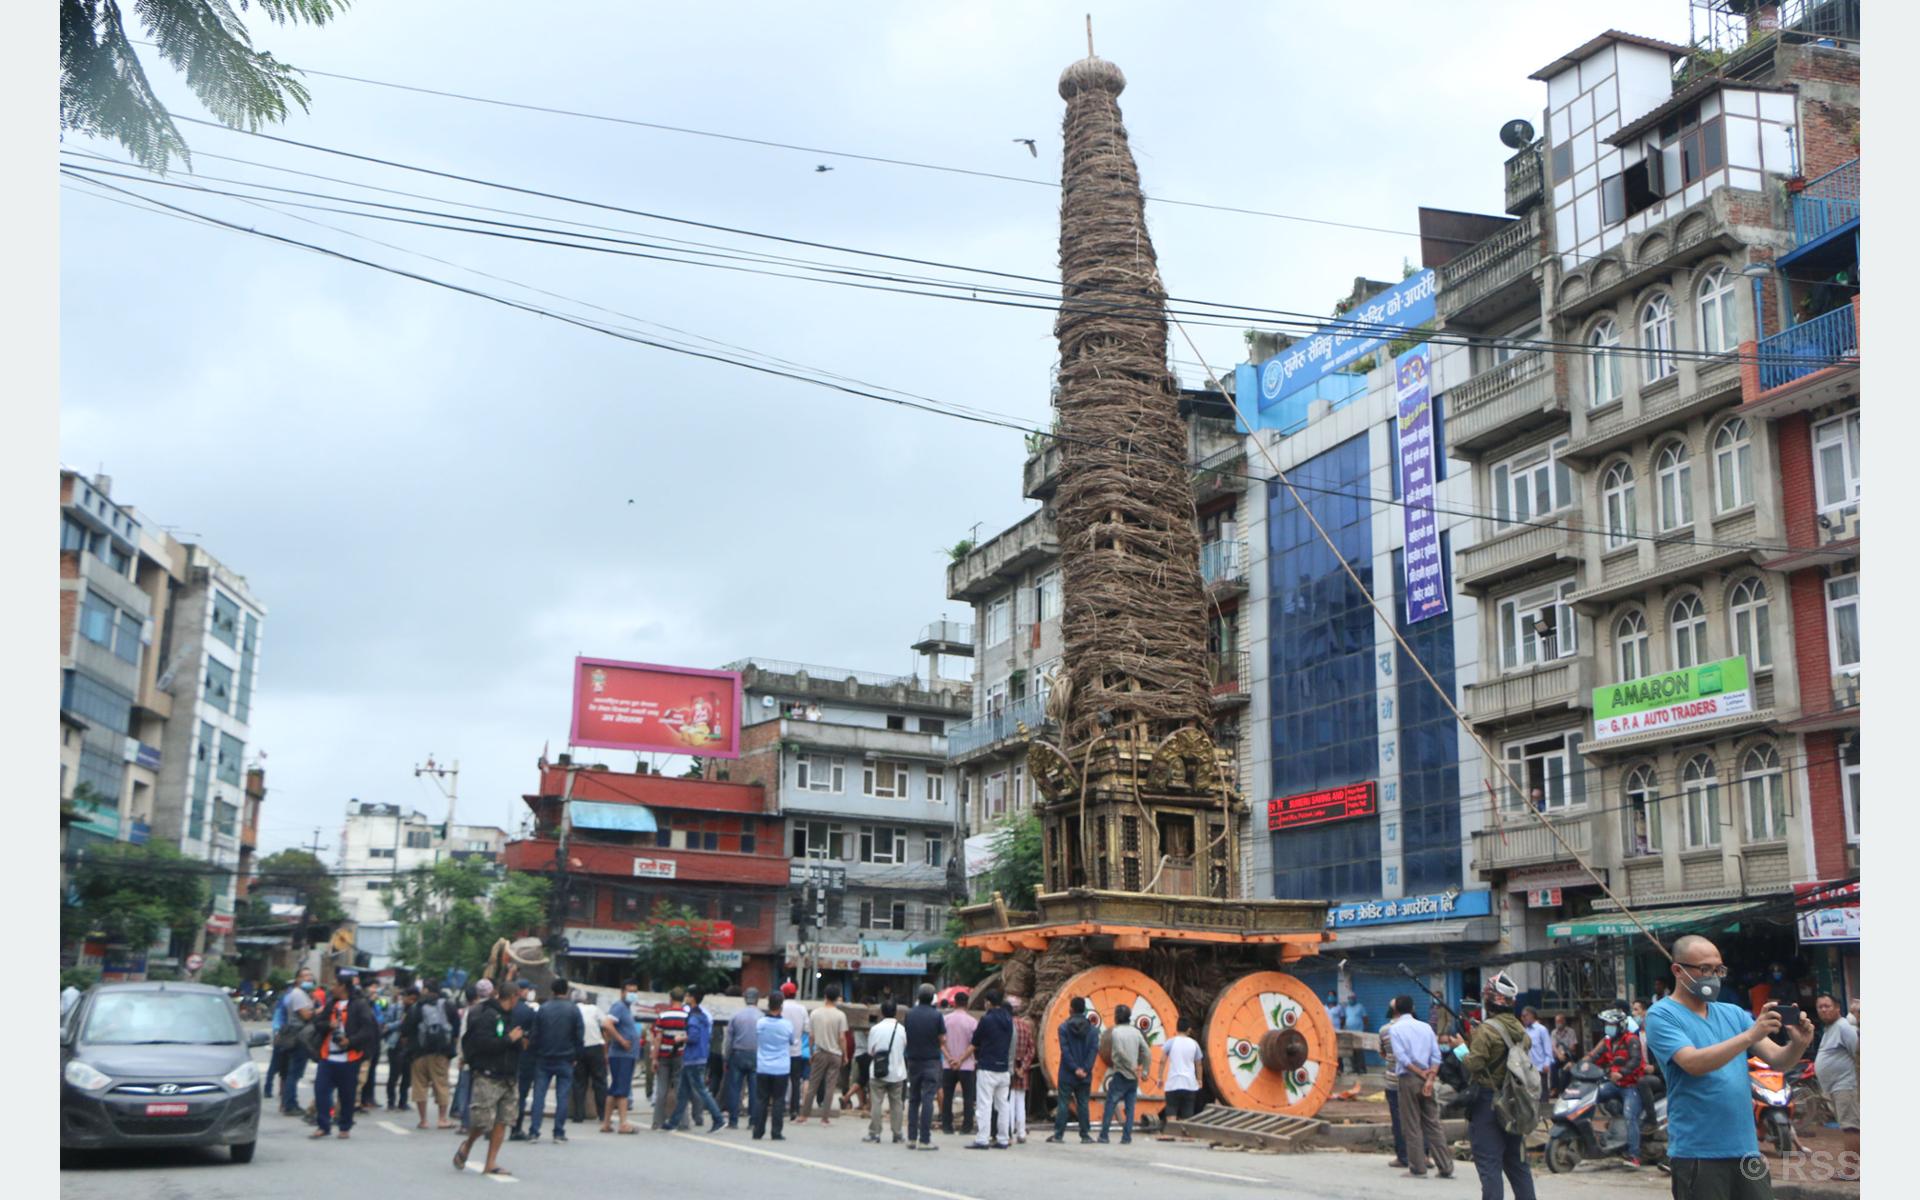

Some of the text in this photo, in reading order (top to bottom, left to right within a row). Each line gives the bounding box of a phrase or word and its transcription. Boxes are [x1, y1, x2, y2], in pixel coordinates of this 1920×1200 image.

[1611, 672, 1690, 709] AMARON
[1644, 708, 1669, 727] AUTO
[1671, 699, 1718, 722] TRADERS
[831, 945, 860, 955] SERVICE
